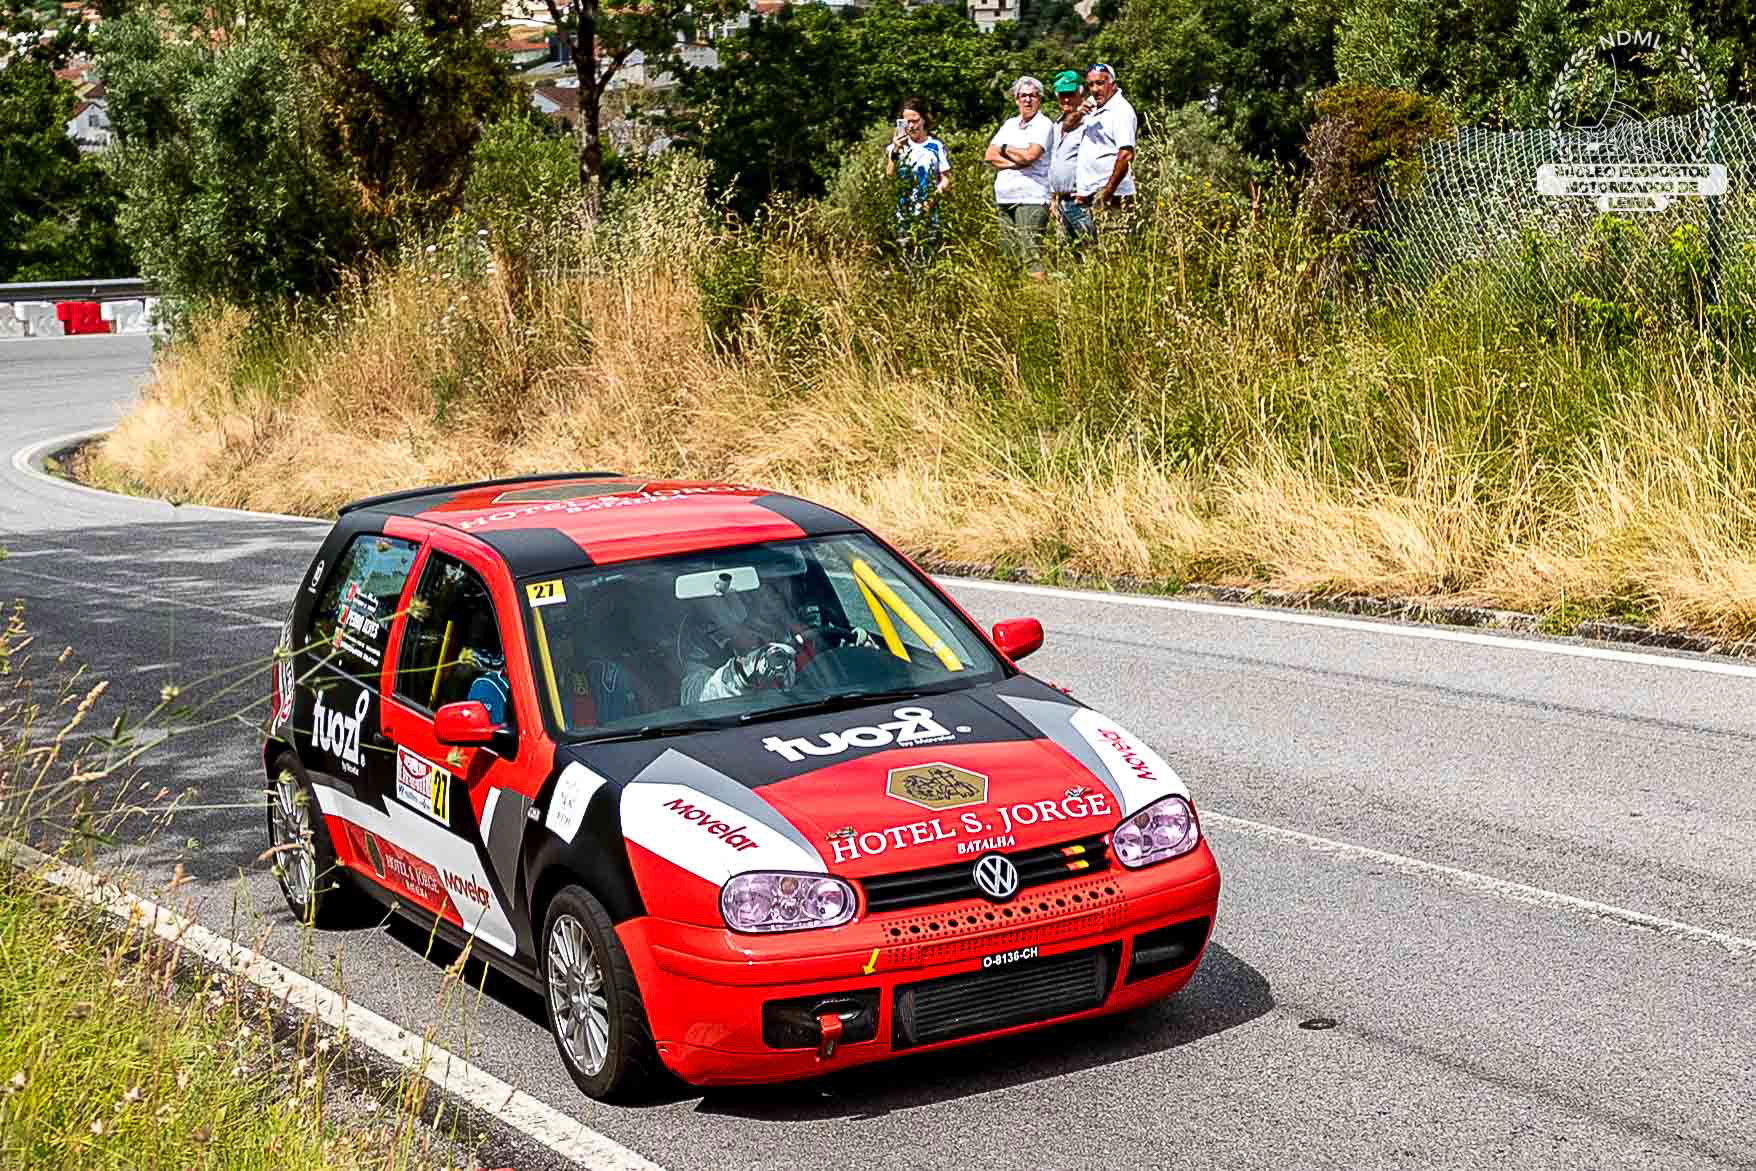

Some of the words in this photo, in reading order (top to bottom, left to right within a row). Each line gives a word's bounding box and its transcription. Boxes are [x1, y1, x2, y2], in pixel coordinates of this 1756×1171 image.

[534, 583, 554, 599] 27
[433, 769, 448, 819] 27
[662, 797, 759, 852] Movelar
[830, 818, 957, 865] HOTEL
[960, 812, 992, 834] S.
[997, 792, 1112, 833] JORGE
[956, 834, 1016, 855] BATALHA
[442, 867, 491, 910] Movelar
[983, 946, 1038, 968] O-8136-CH
